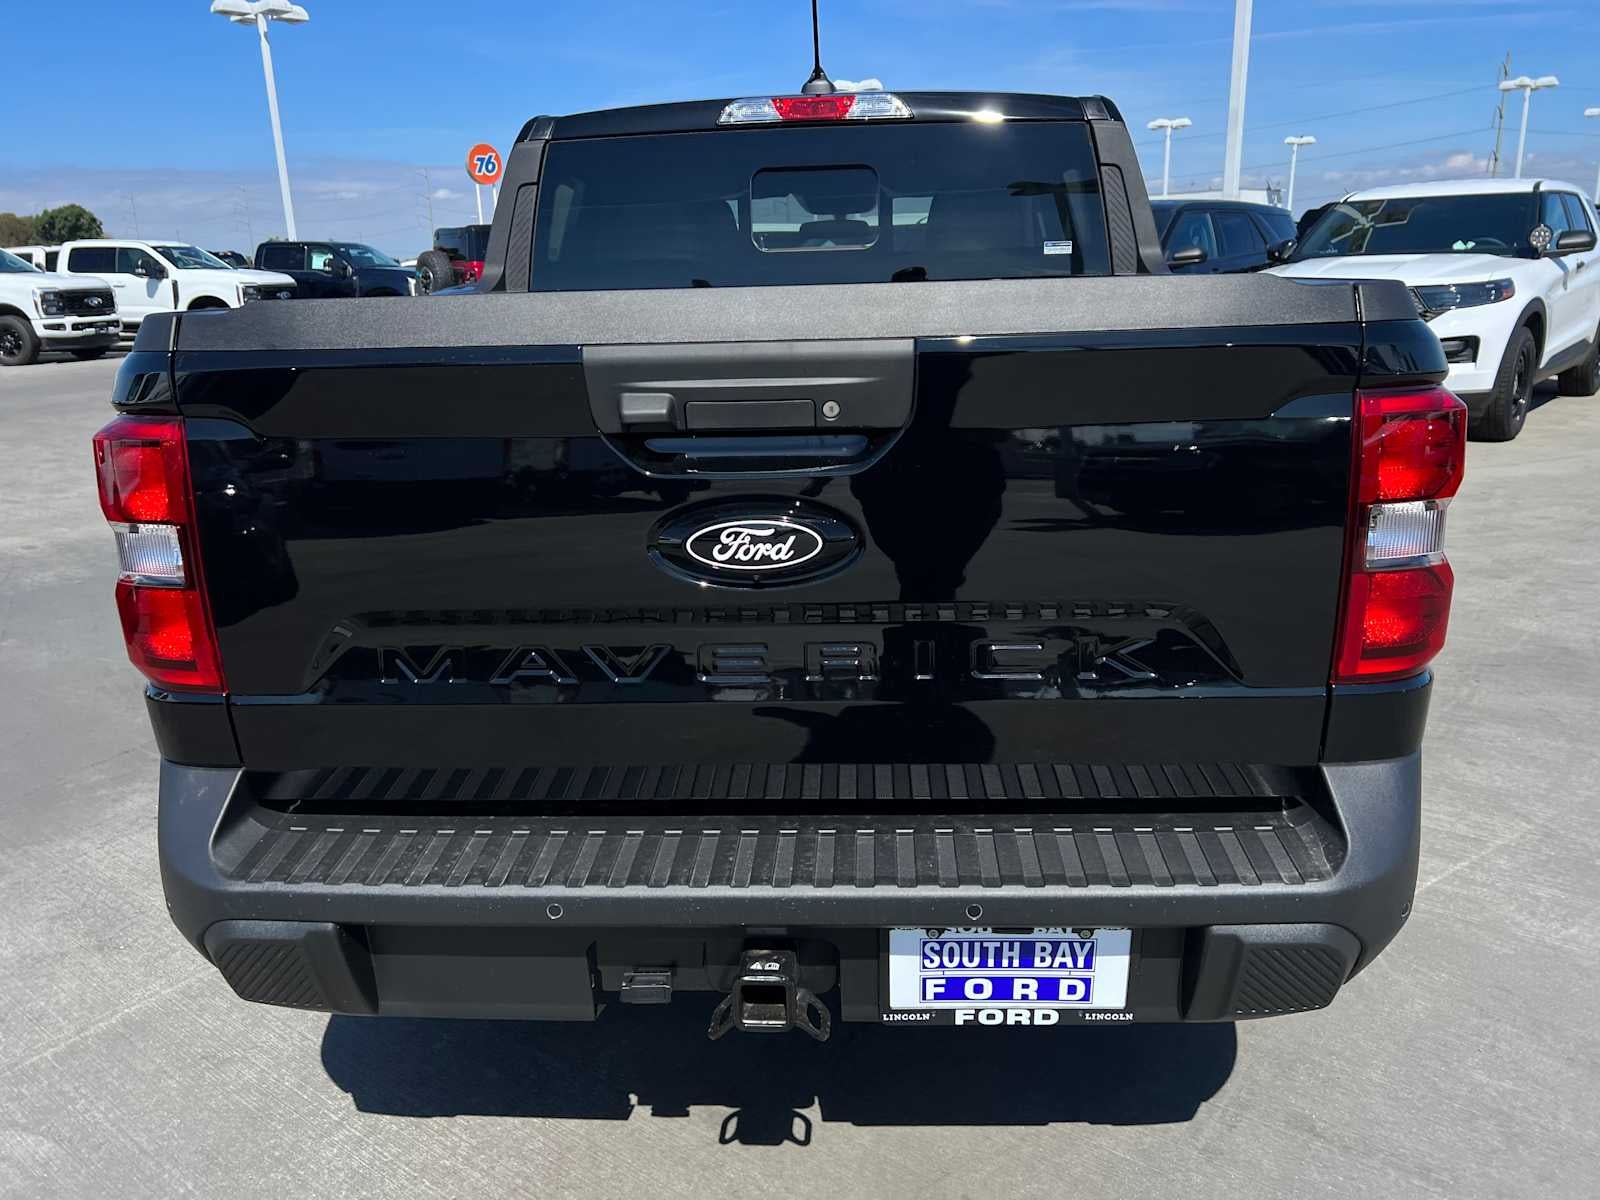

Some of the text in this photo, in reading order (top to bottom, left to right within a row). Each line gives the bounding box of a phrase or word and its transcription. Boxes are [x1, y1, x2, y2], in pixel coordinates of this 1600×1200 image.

[474, 153, 498, 176] 76
[712, 527, 797, 562] Ford
[376, 641, 1160, 684] MAVERICK
[923, 941, 1093, 968] SOUTH BAY
[925, 978, 1087, 1000] FORD
[882, 1013, 931, 1021] LINCOLN
[955, 1009, 1059, 1025] FORD
[1085, 1012, 1134, 1021] LINCOLN
